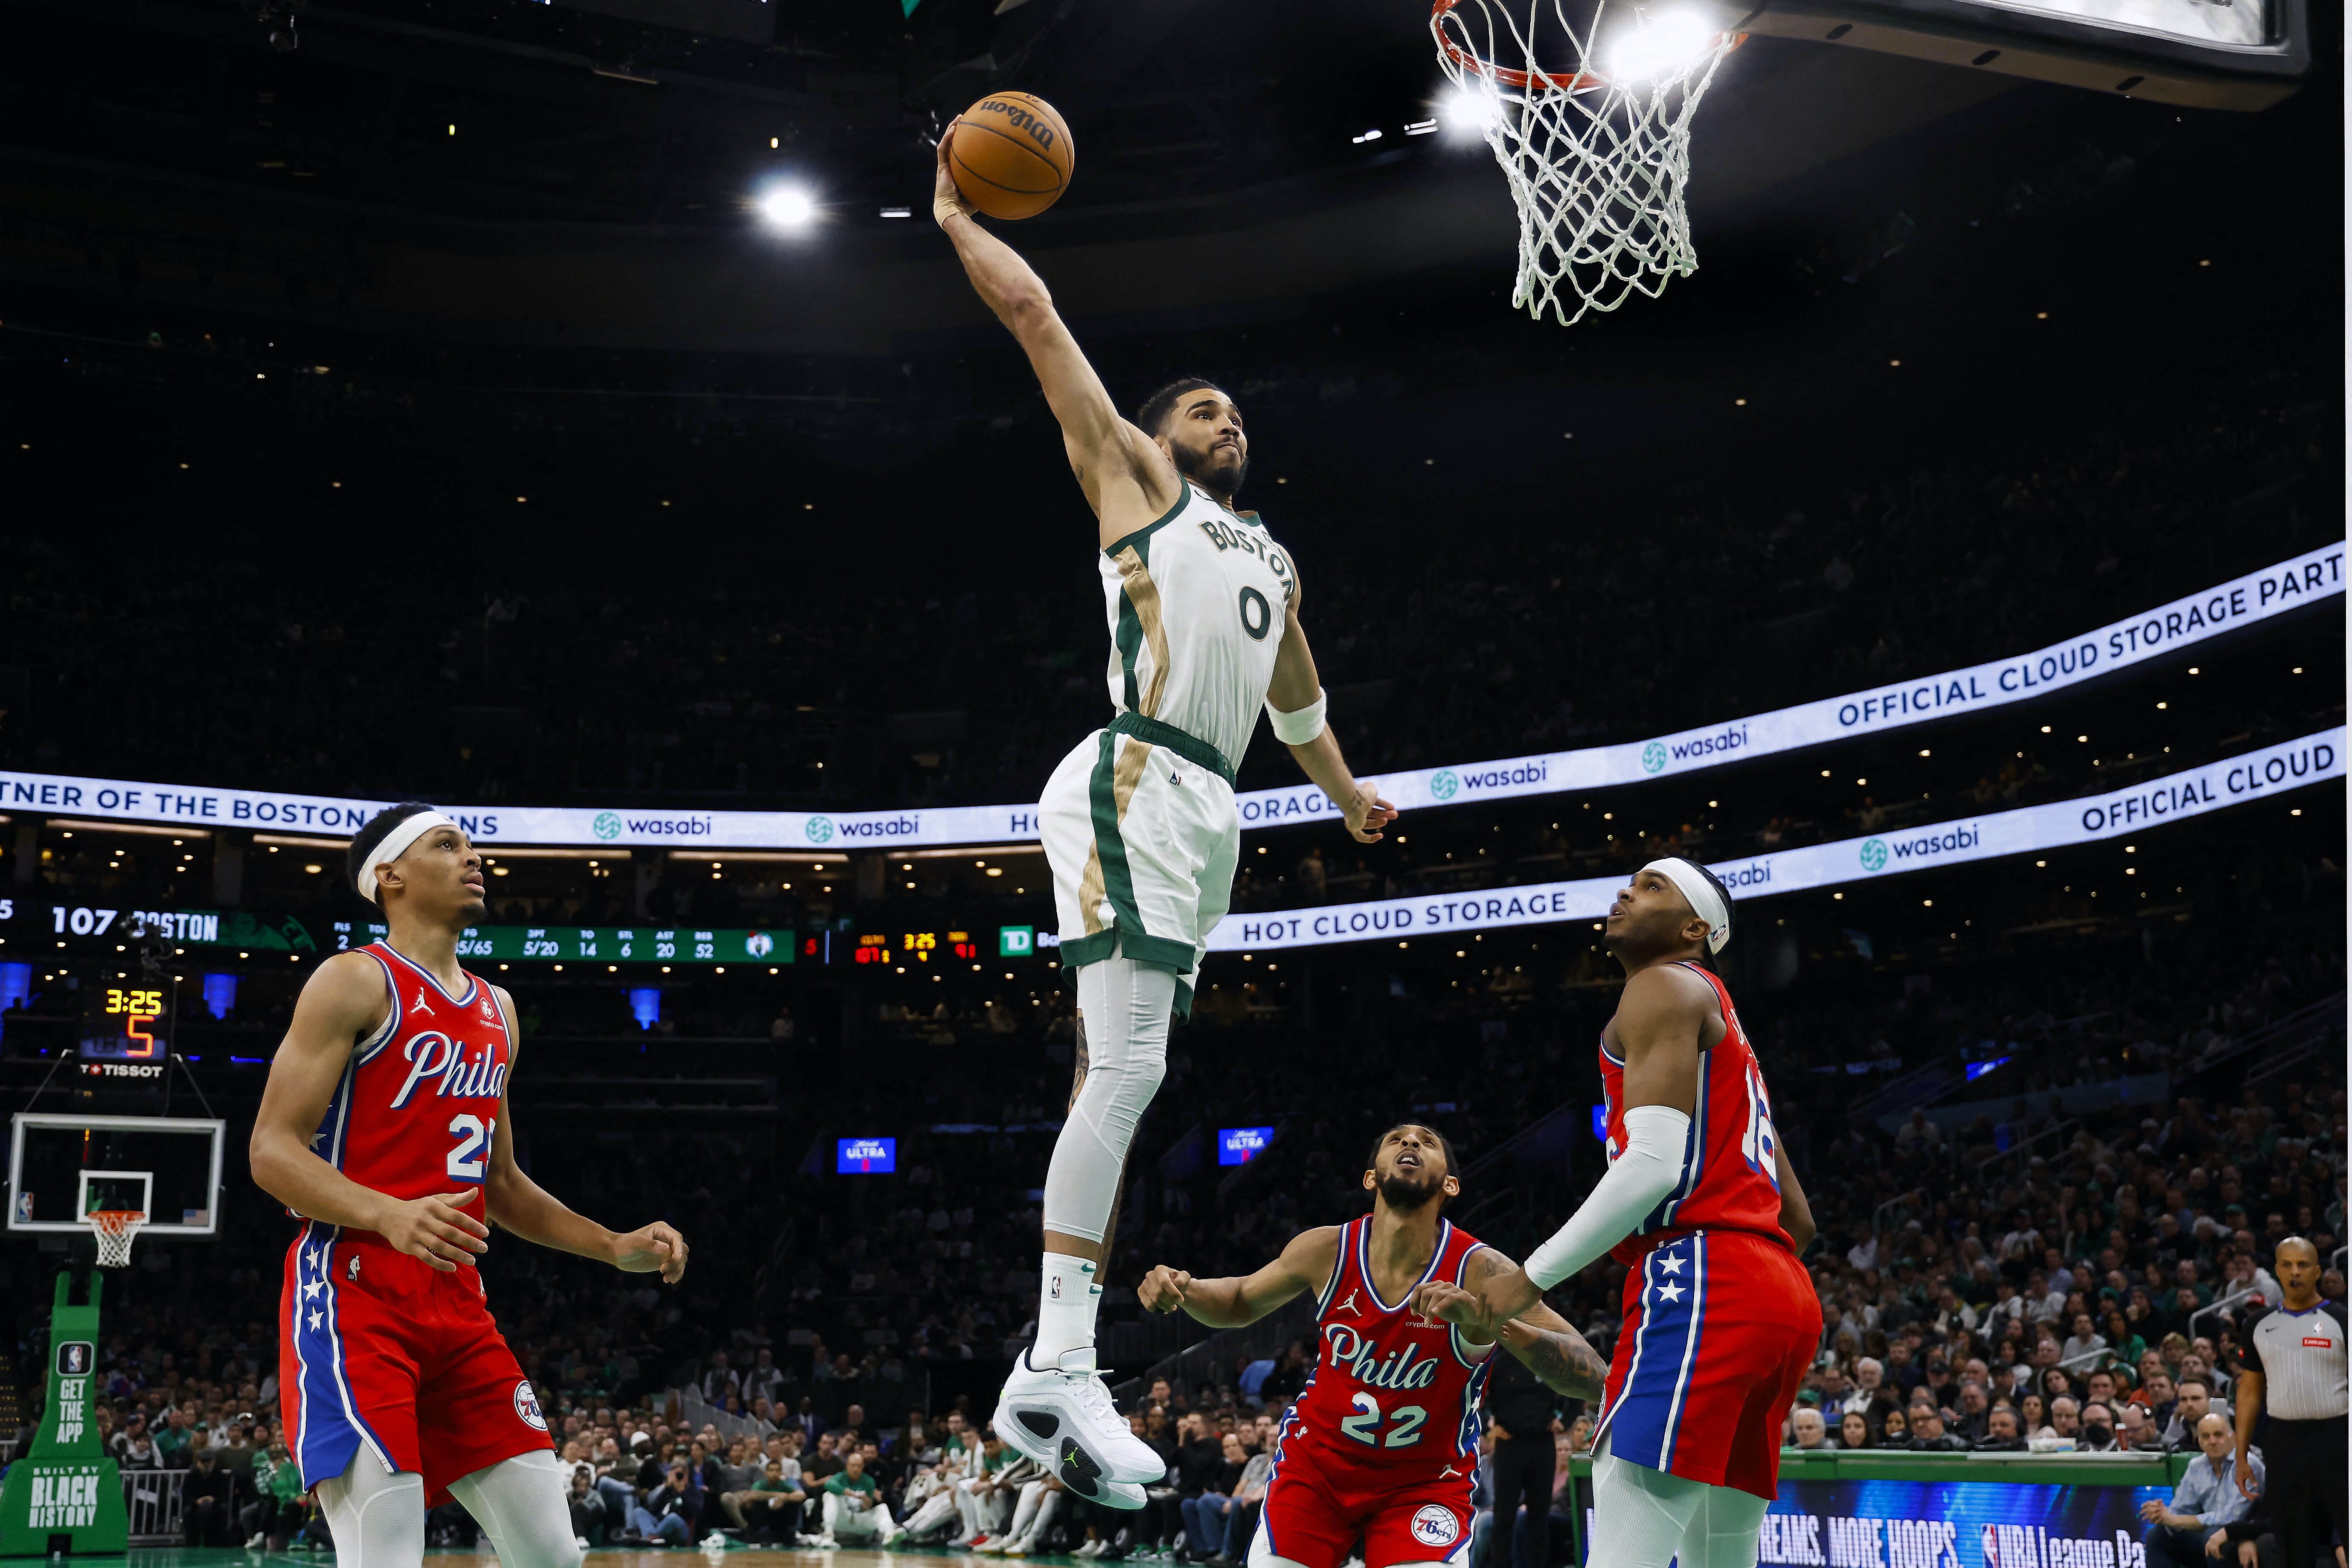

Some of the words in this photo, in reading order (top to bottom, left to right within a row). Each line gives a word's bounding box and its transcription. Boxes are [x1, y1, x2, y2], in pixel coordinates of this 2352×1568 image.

[981, 101, 1054, 152] Wilson
[1197, 521, 1292, 602] BOSTON
[1239, 585, 1271, 642] 0
[1839, 676, 1986, 726] OFFICIAL
[1999, 643, 2097, 692] CLOUD
[2110, 588, 2247, 658] STORAGE
[2260, 553, 2343, 607] PART
[1671, 724, 1747, 761] wasabi
[1464, 761, 1547, 789] wasabi
[2082, 777, 2215, 831] OFFICIAL
[2227, 745, 2334, 794] CLOUD
[97, 789, 142, 810] OF
[155, 793, 218, 817] THE
[233, 799, 364, 828] BOSTON
[1236, 794, 1339, 820] ORAG
[628, 816, 712, 835] wasabi
[839, 815, 919, 837] wasabi
[1893, 824, 1979, 858] wasabi
[1717, 861, 1770, 887] asabi
[52, 906, 118, 936] 107
[1243, 919, 1302, 942] HOT
[1314, 908, 1412, 936] CLOUD
[1426, 892, 1567, 925] STORAGE
[337, 935, 349, 950] 2
[455, 940, 493, 956] 5/65
[523, 940, 559, 957] 5/20
[579, 942, 597, 957] 14
[620, 942, 632, 958] 6
[655, 943, 676, 959] 20
[695, 943, 714, 959] 52
[1003, 931, 1030, 950] TD
[106, 989, 162, 1015] 3:25
[126, 1015, 155, 1057] 5
[480, 1019, 504, 1030] crypto.com
[102, 1064, 163, 1078] TISSOT
[390, 1030, 506, 1109] Phila
[1326, 1323, 1439, 1390] Phila
[60, 1379, 86, 1401] GET
[59, 1400, 84, 1422] THE
[1341, 1391, 1427, 1447] 22
[56, 1422, 84, 1444] APP
[31, 1475, 99, 1507] BLACK
[29, 1506, 96, 1528] HISTORY
[1416, 1518, 1451, 1539] 76ers
[1756, 1513, 1827, 1566] REAMS.
[1827, 1516, 1886, 1568] MORE
[1997, 1524, 2039, 1568] NBA
[2038, 1526, 2115, 1568] League
